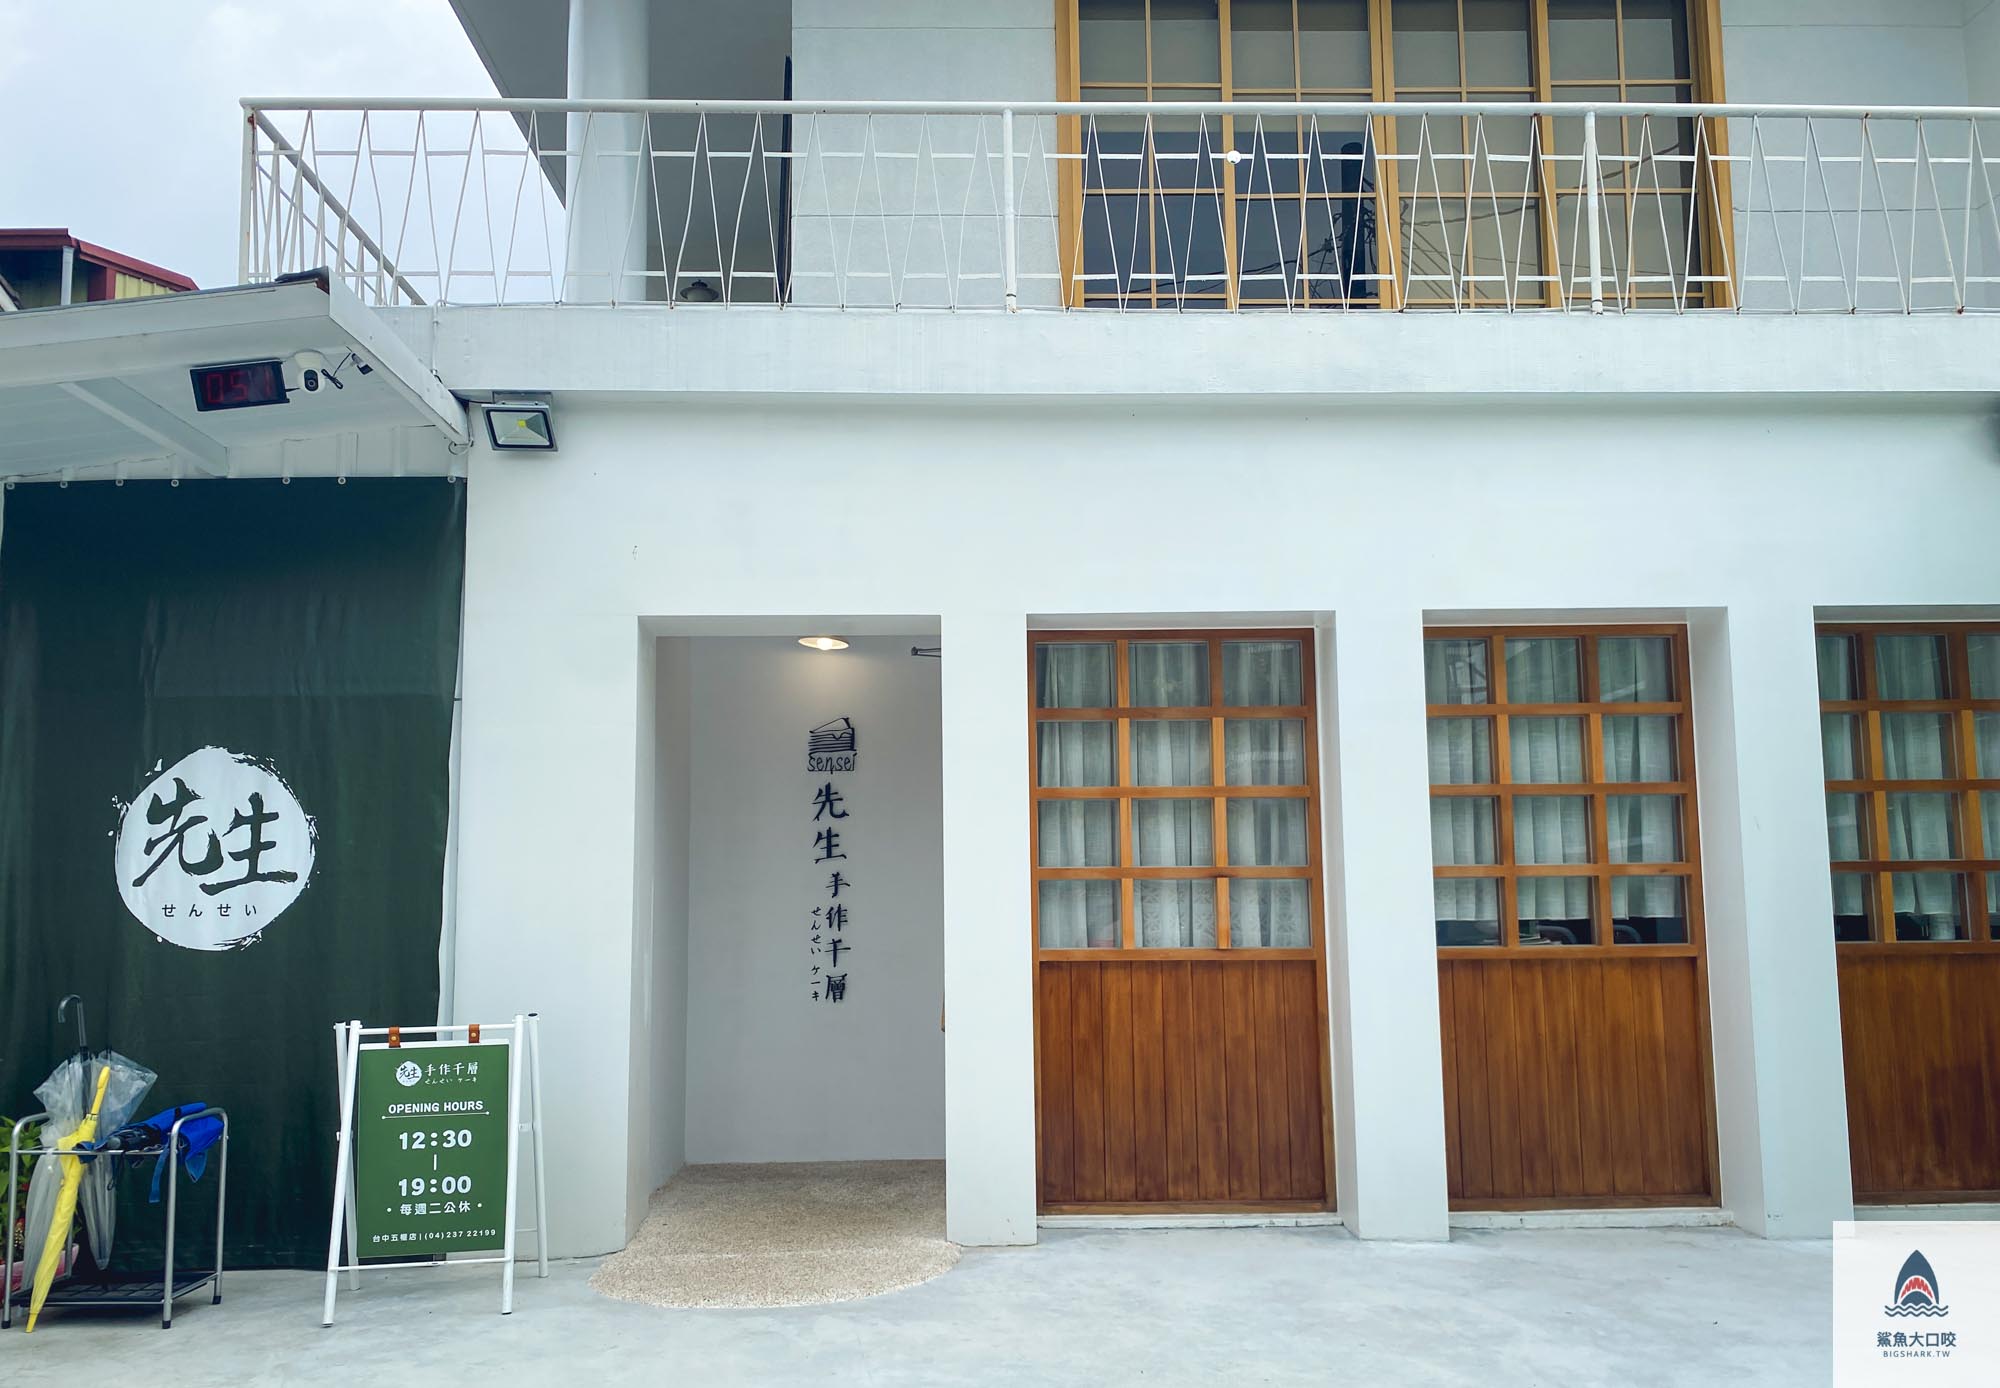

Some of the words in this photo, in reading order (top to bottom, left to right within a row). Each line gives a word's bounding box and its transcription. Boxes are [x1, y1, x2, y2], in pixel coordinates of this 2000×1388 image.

[132, 778, 298, 896] 先生
[161, 903, 257, 918] せんせい
[424, 1062, 478, 1076] 手作千層
[388, 1103, 440, 1114] OPENING
[443, 1100, 484, 1112] HOURS
[399, 1129, 473, 1150] 12:30
[398, 1175, 472, 1197] 19:00
